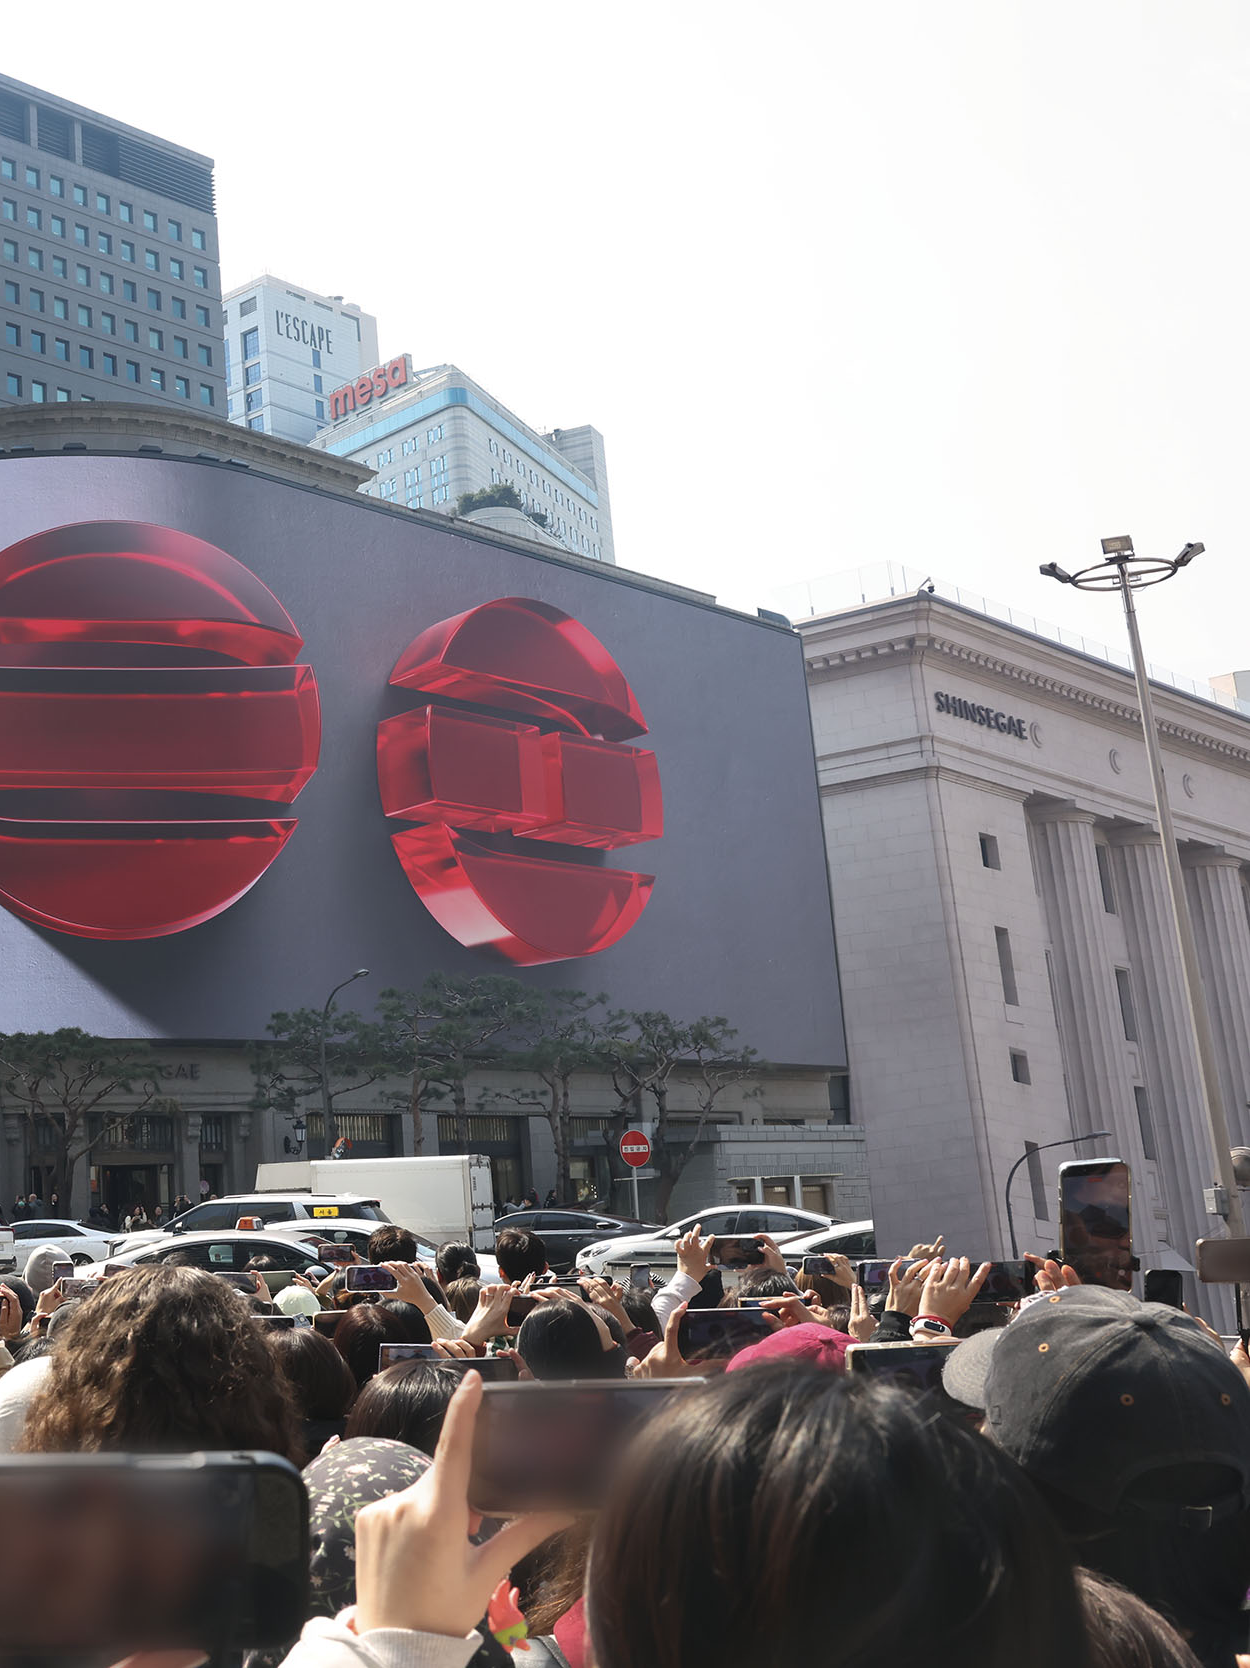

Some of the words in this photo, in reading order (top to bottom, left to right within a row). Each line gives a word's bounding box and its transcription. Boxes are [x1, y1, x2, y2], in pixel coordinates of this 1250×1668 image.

[276, 310, 333, 354] L'ESCAPE
[329, 357, 407, 420] mesa
[934, 691, 1028, 740] SHINSEGAE
